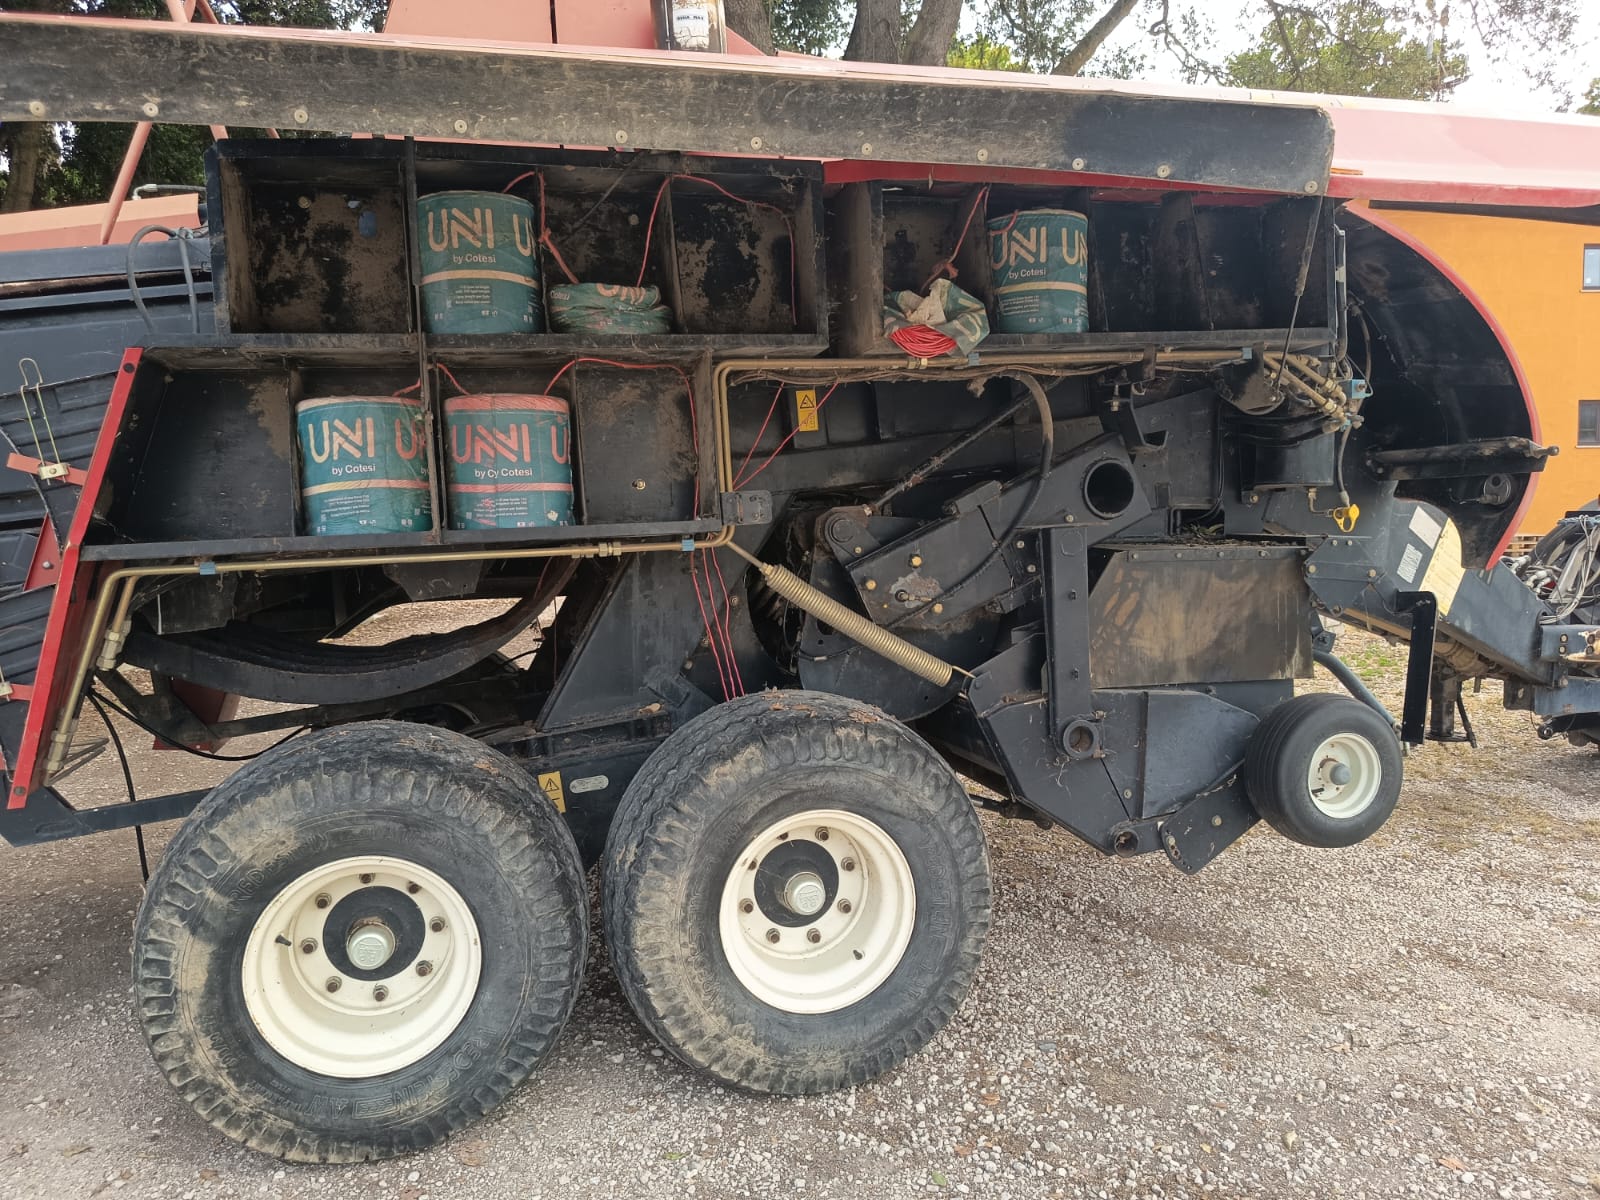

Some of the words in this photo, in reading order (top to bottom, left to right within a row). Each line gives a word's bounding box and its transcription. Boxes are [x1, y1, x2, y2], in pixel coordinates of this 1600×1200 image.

[428, 207, 494, 252] UNI
[453, 254, 463, 264] by
[465, 254, 496, 263] Cotesi
[1008, 271, 1019, 280] by
[1020, 268, 1047, 278] Cotesi
[308, 417, 375, 463] UNI
[331, 466, 343, 476] by
[345, 464, 376, 474] Cotesi
[475, 468, 486, 478] by
[501, 468, 533, 477] Cotesi
